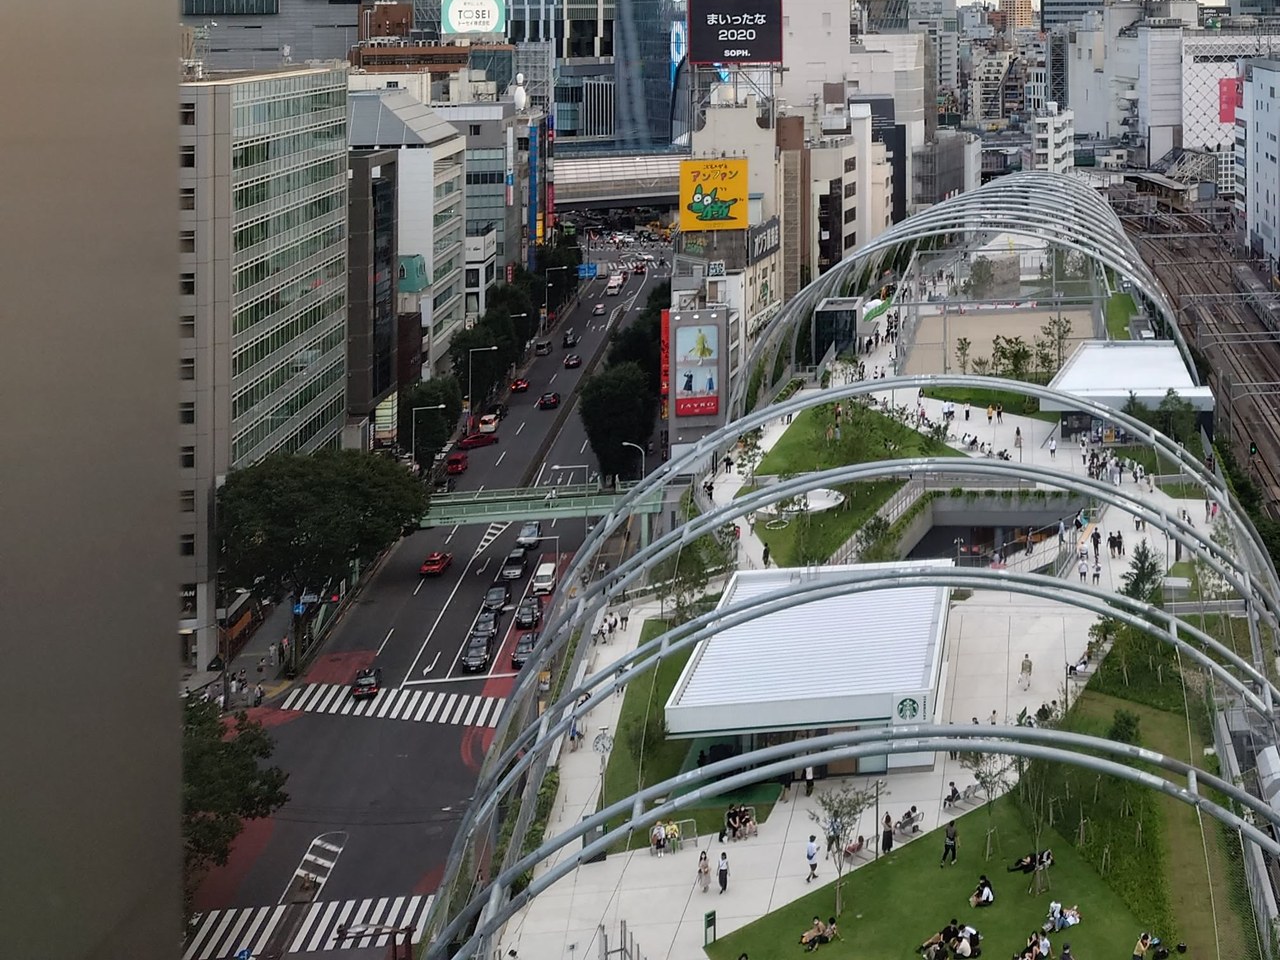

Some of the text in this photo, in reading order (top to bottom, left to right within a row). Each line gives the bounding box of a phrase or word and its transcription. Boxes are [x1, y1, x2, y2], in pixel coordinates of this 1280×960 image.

[707, 13, 766, 25] まいったな
[718, 29, 756, 41] 2020
[723, 49, 751, 57] SOPH.
